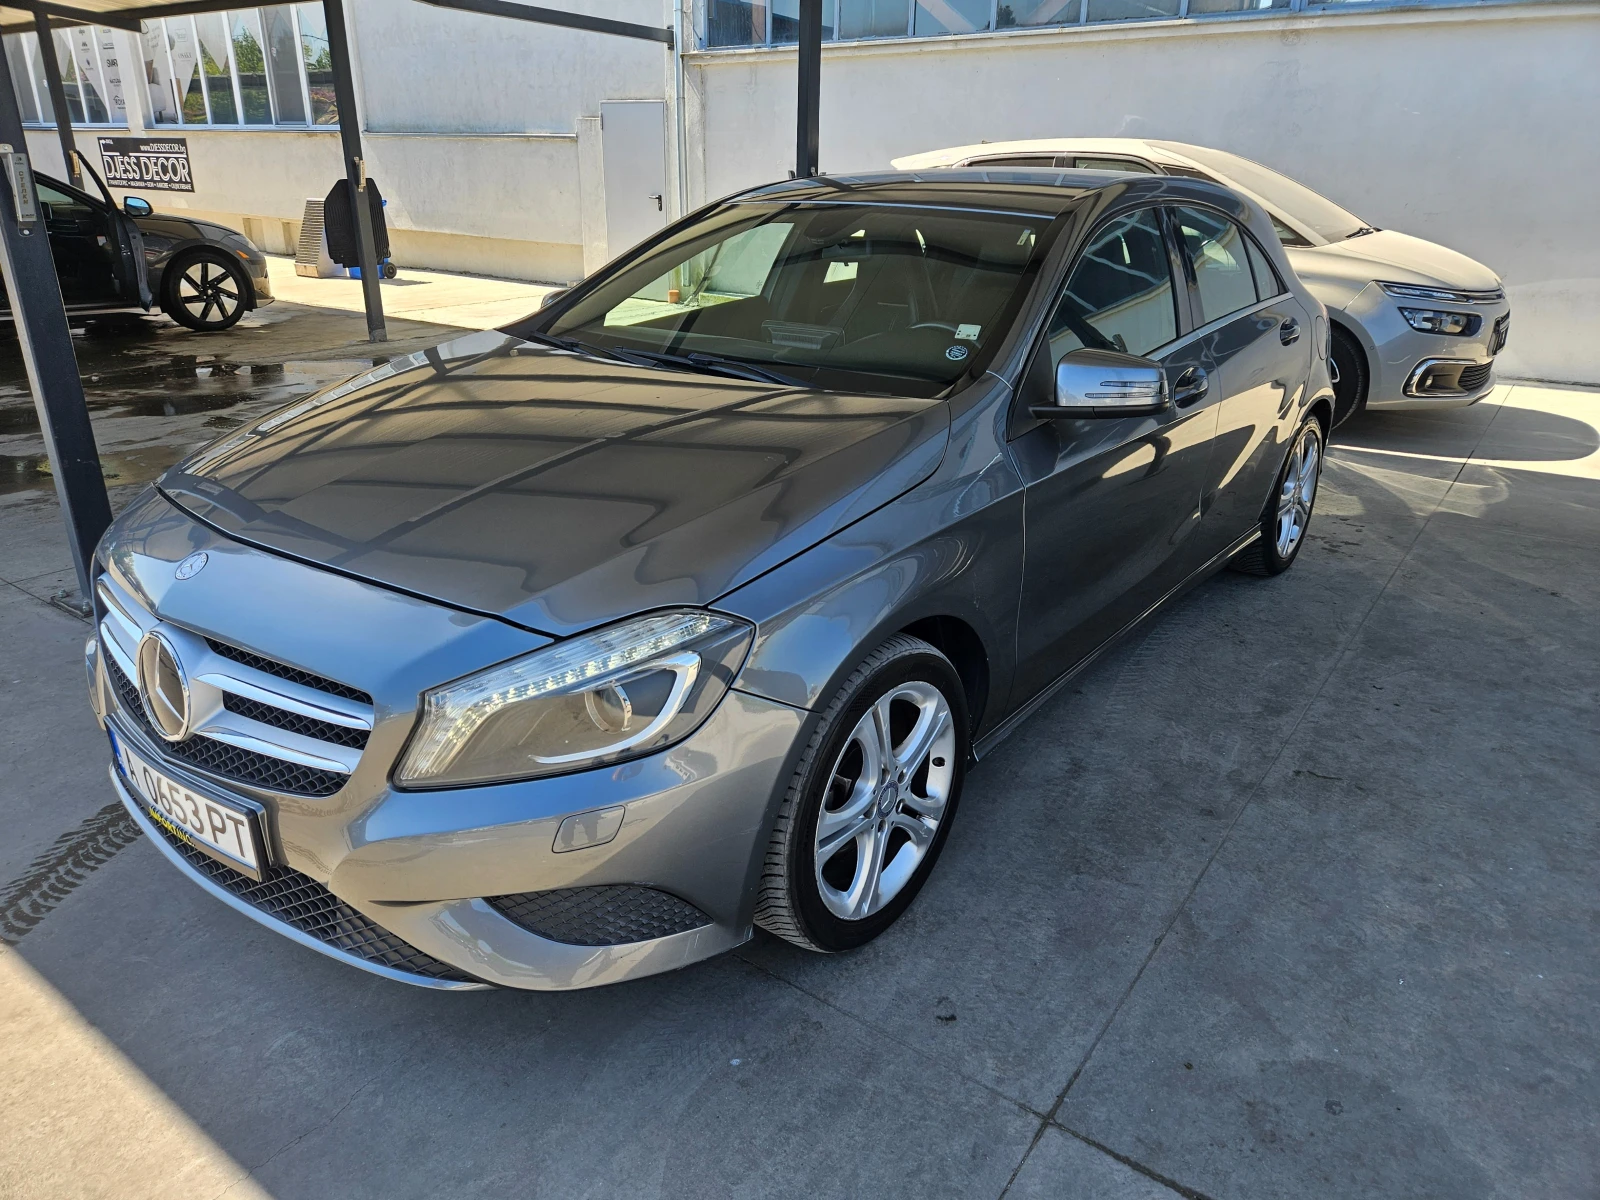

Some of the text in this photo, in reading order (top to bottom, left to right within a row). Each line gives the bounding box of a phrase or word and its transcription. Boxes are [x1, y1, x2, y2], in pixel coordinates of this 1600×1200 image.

[103, 156, 191, 183] DJESS DECOR
[124, 747, 246, 858] A 0653 PT
